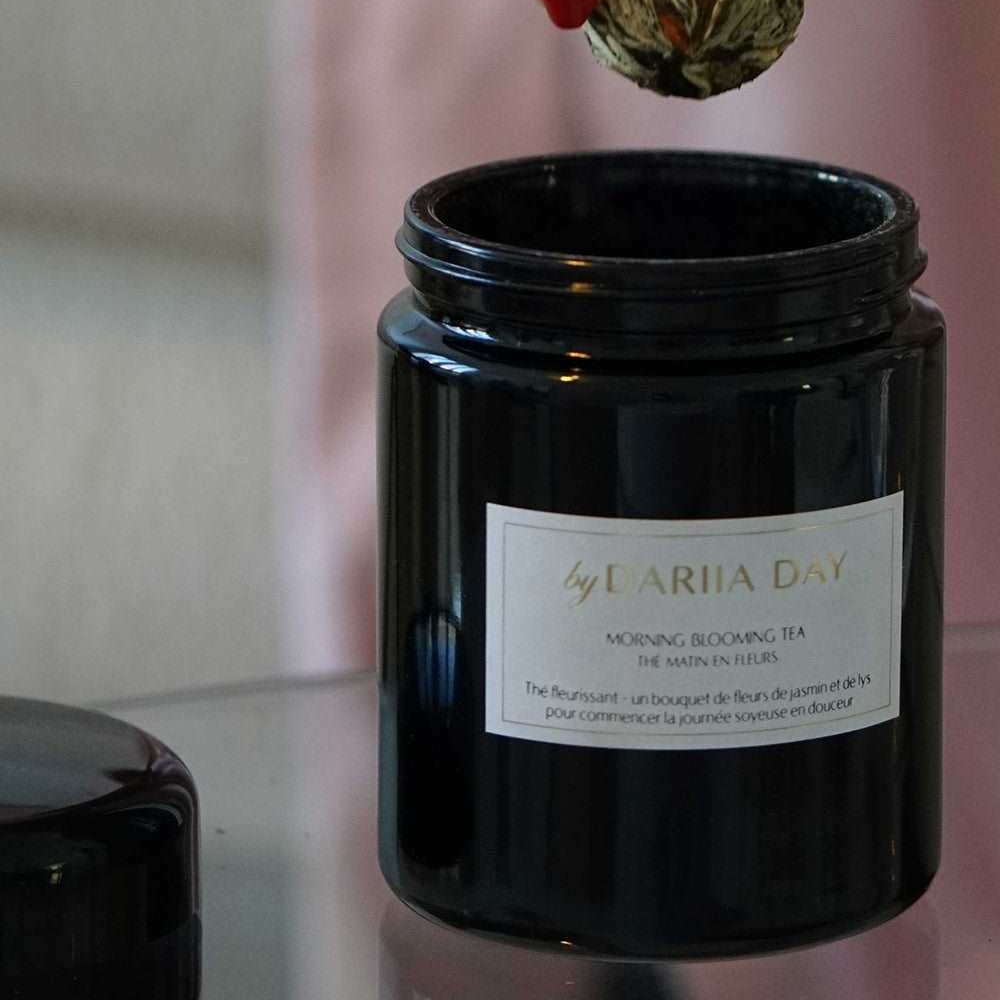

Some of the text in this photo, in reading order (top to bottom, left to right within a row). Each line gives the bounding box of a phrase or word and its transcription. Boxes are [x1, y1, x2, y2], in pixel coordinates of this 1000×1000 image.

[563, 551, 848, 606] by DARIIA DAY
[606, 626, 806, 648] MORNING BLOOMING TEA
[666, 655, 708, 668] MATIN
[713, 655, 730, 668] EN
[734, 650, 778, 666] FLEURS
[525, 680, 548, 698] Thé
[551, 684, 618, 705] fleurissant
[631, 695, 649, 705] un
[651, 692, 709, 709] bouquet
[713, 691, 730, 705] de
[734, 689, 768, 704] fleurs
[771, 687, 788, 701] de
[790, 682, 827, 701] jasmin
[829, 679, 841, 693] et
[843, 675, 856, 690] de
[857, 672, 872, 689] lys
[545, 696, 854, 728] pour commencer la journée soyeuse en douceur
